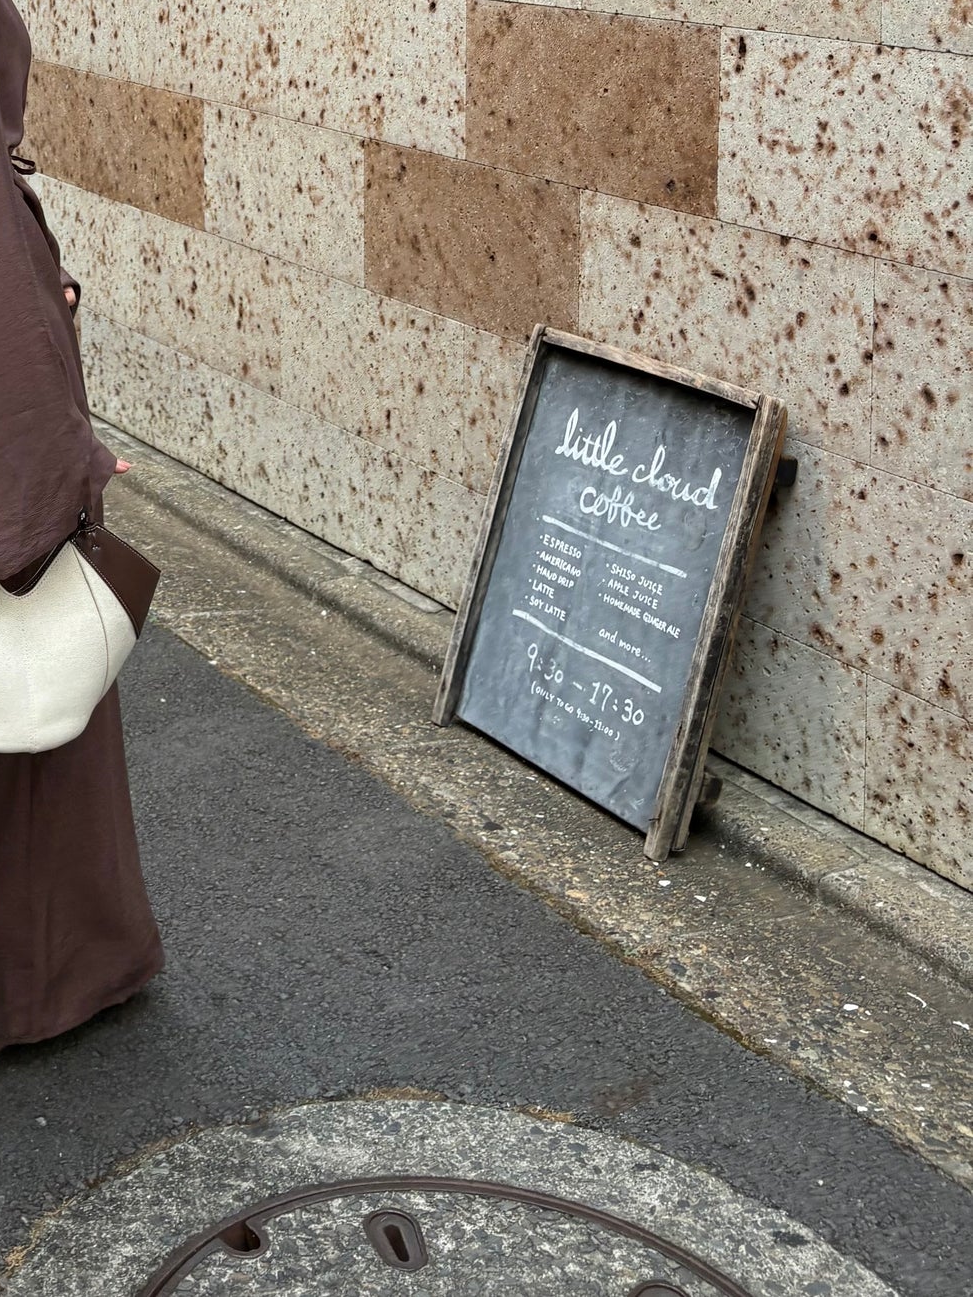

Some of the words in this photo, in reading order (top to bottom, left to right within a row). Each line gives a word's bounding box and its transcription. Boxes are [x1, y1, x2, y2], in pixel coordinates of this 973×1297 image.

[554, 407, 628, 475] little
[631, 444, 723, 509] cloud
[579, 485, 662, 531] coffee
[542, 534, 582, 559] ESPRESSO
[536, 564, 558, 581] HAND
[557, 575, 575, 588] DRIP
[539, 551, 582, 577] AMERICANO
[532, 579, 555, 599] LATTE
[610, 563, 636, 581] SHISO
[638, 576, 663, 596] JUICE
[607, 578, 629, 596] APPLE
[632, 590, 658, 610] JUICE
[528, 595, 544, 610] SOY
[544, 603, 567, 622] LATTE
[603, 593, 642, 619] HOMEMADE
[642, 612, 667, 633] GINGER
[666, 624, 681, 639] ALE
[598, 628, 618, 644] and
[527, 643, 564, 683] 9:30
[589, 681, 645, 726] 17:30
[556, 697, 565, 707] TO
[565, 702, 574, 714] GO
